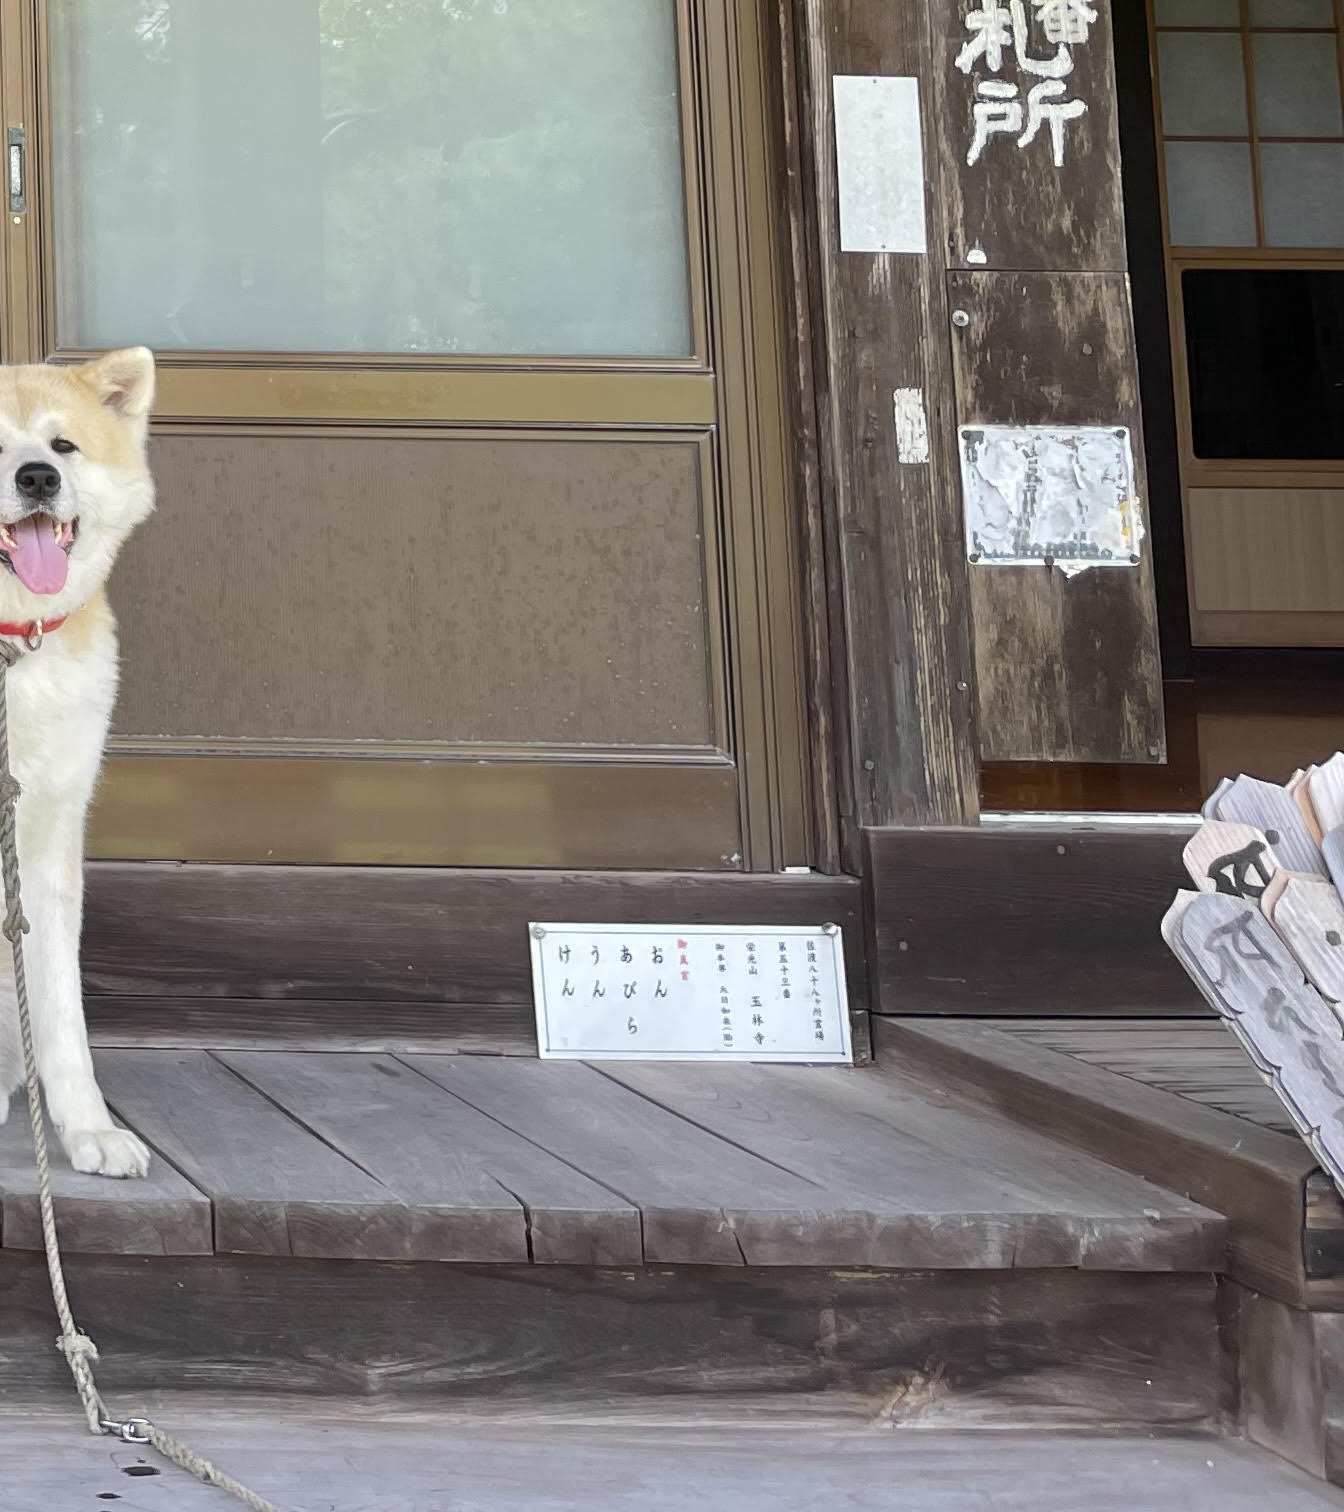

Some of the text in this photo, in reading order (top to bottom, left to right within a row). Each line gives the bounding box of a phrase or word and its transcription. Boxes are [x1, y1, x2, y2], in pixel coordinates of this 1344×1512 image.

[558, 945, 577, 998] けん
[589, 944, 607, 998] うん
[650, 945, 669, 999] おん
